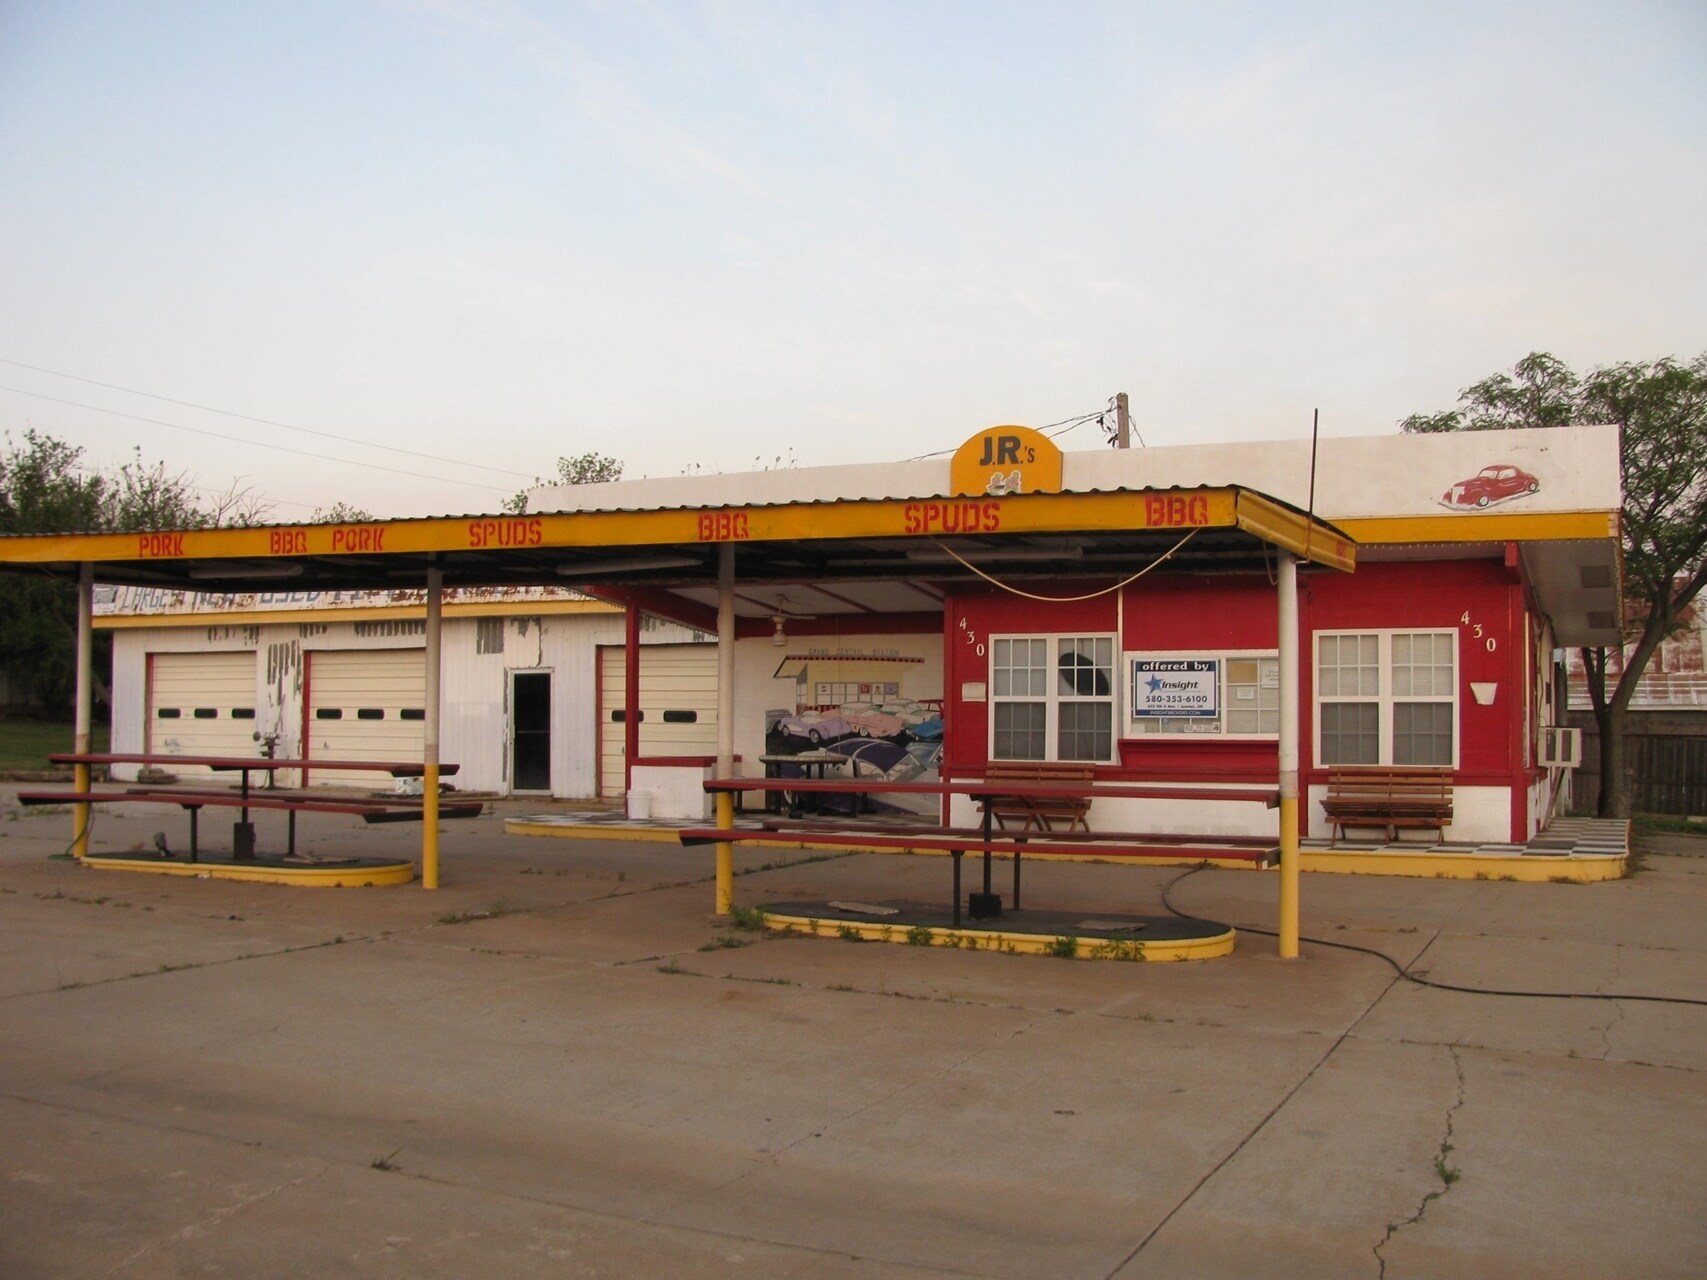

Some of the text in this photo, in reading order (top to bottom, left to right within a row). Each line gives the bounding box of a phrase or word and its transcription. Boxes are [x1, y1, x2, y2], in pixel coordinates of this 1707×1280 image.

[137, 495, 1209, 557] PORK BBQ PORK SPUDS BBQ SPUDS BBQ
[1460, 610, 1497, 652] 430
[959, 617, 985, 657] 430
[836, 648, 864, 657] CENTRAL
[872, 648, 900, 657] STATION
[1142, 661, 1209, 672] offered by
[1161, 681, 1199, 691] Insight
[1145, 695, 1208, 703] 580-353-6100
